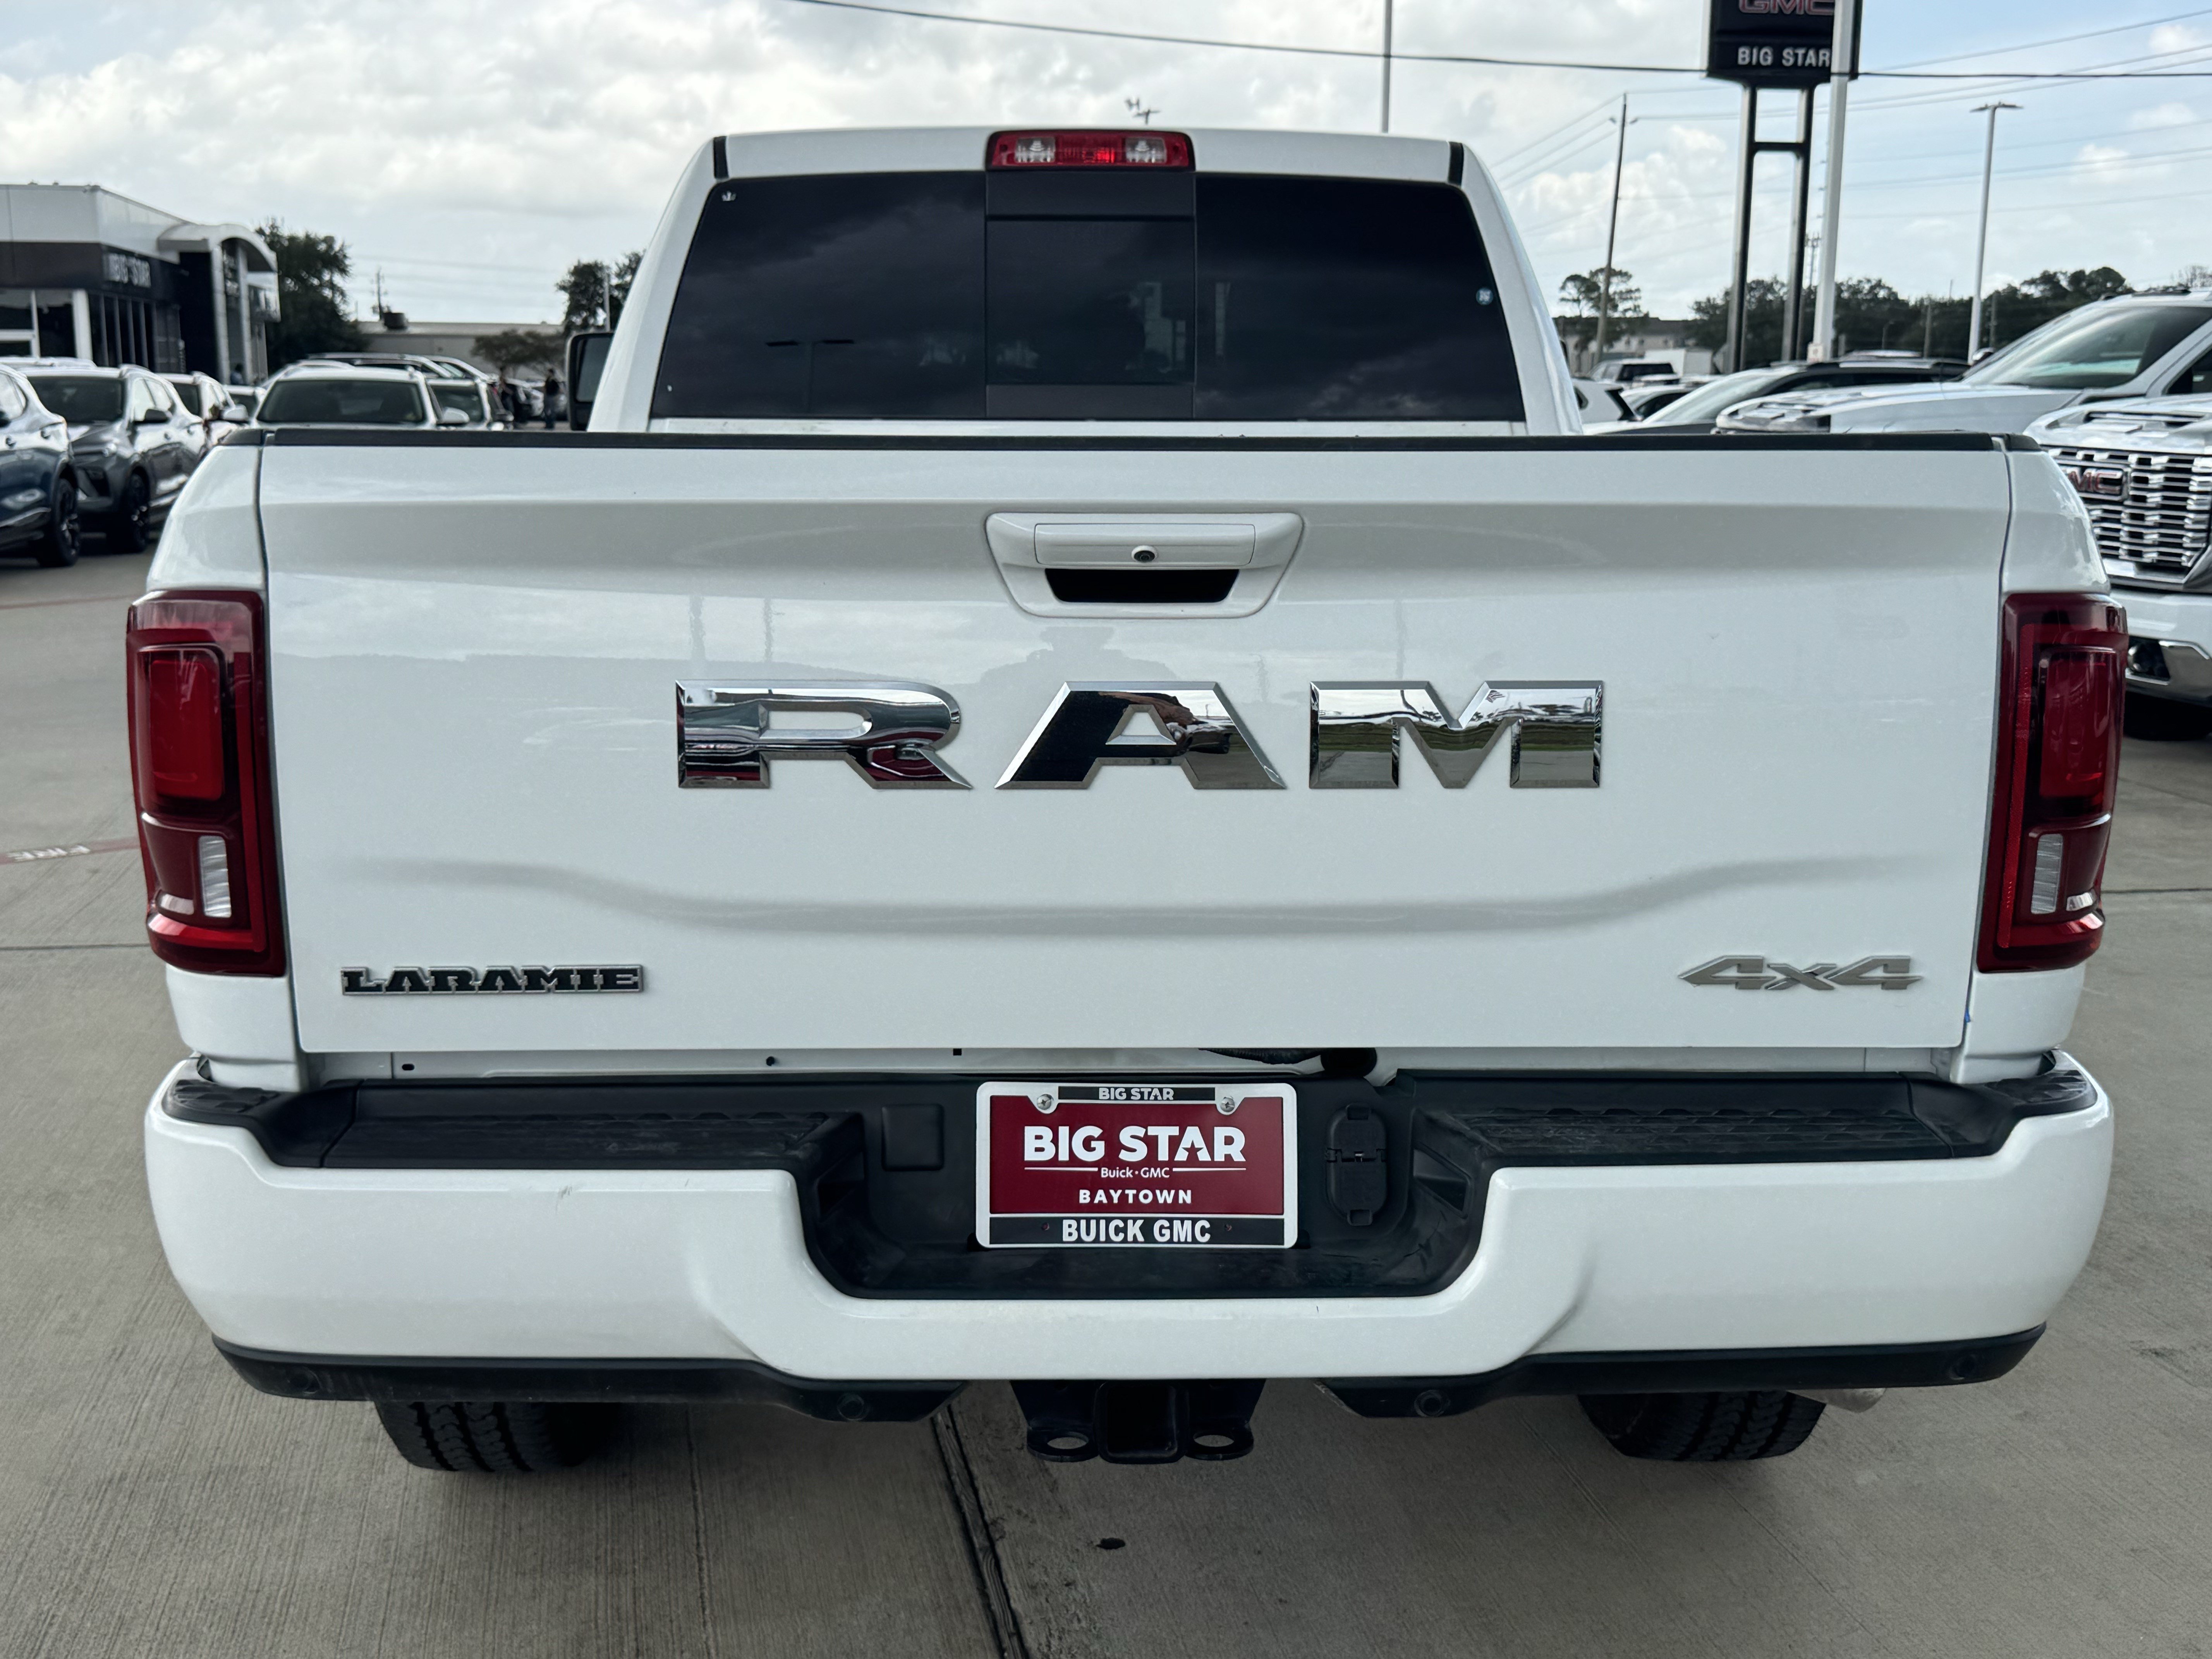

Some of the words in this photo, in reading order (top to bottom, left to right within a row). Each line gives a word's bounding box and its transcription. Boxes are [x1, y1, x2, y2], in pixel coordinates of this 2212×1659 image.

[1739, 0, 1835, 15] GMC
[1738, 46, 1773, 66] BIG
[1782, 47, 1831, 67] STAR
[2060, 467, 2123, 495] MC
[677, 680, 1605, 789] RAM
[341, 965, 644, 996] LARAMIE
[1099, 1087, 1127, 1100] BIG
[1130, 1088, 1174, 1100] STAR
[1024, 1126, 1105, 1161] BIG
[1119, 1126, 1246, 1162] STAR
[1079, 1190, 1192, 1204] BAYTOWN
[1062, 1219, 1144, 1242] BUICK
[1154, 1219, 1211, 1242] GMC
